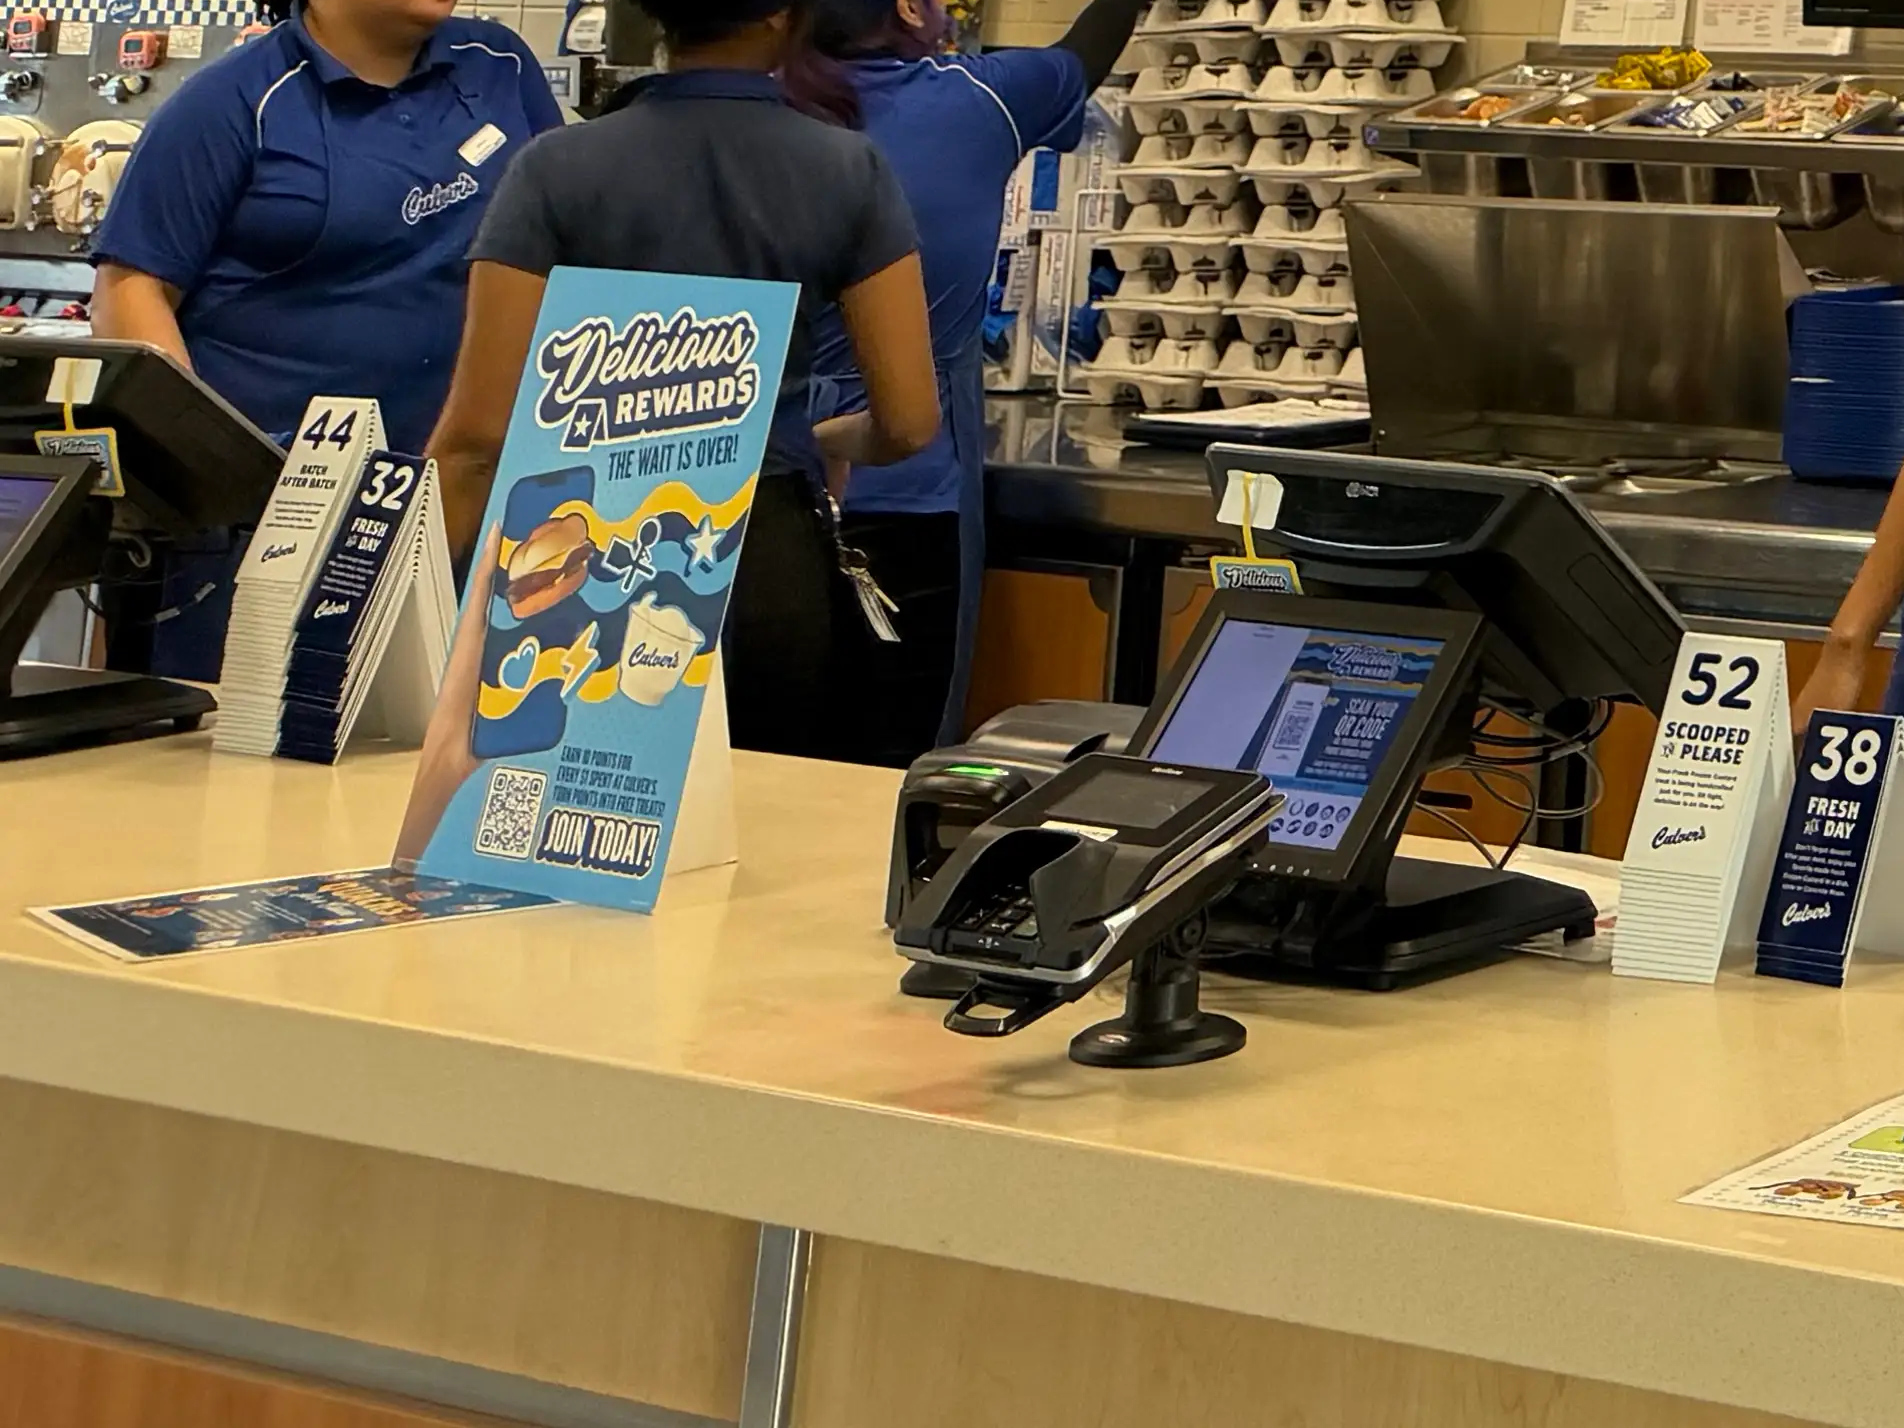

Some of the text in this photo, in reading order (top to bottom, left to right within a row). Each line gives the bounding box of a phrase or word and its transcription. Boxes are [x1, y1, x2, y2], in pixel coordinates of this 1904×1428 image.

[554, 323, 748, 404] Delicious
[615, 373, 754, 425] REWARDS
[303, 410, 357, 451] 44
[608, 434, 739, 482] THE WAIT IS OVER!
[361, 462, 414, 510] 32
[1682, 653, 1759, 710] 52
[1665, 722, 1750, 745] SCOOPED
[1680, 744, 1744, 765] PLEASE
[1811, 726, 1881, 785] 38
[1808, 797, 1860, 819] FRESH
[1824, 820, 1855, 839] DAY
[544, 812, 658, 868] JOIN TODAY!
